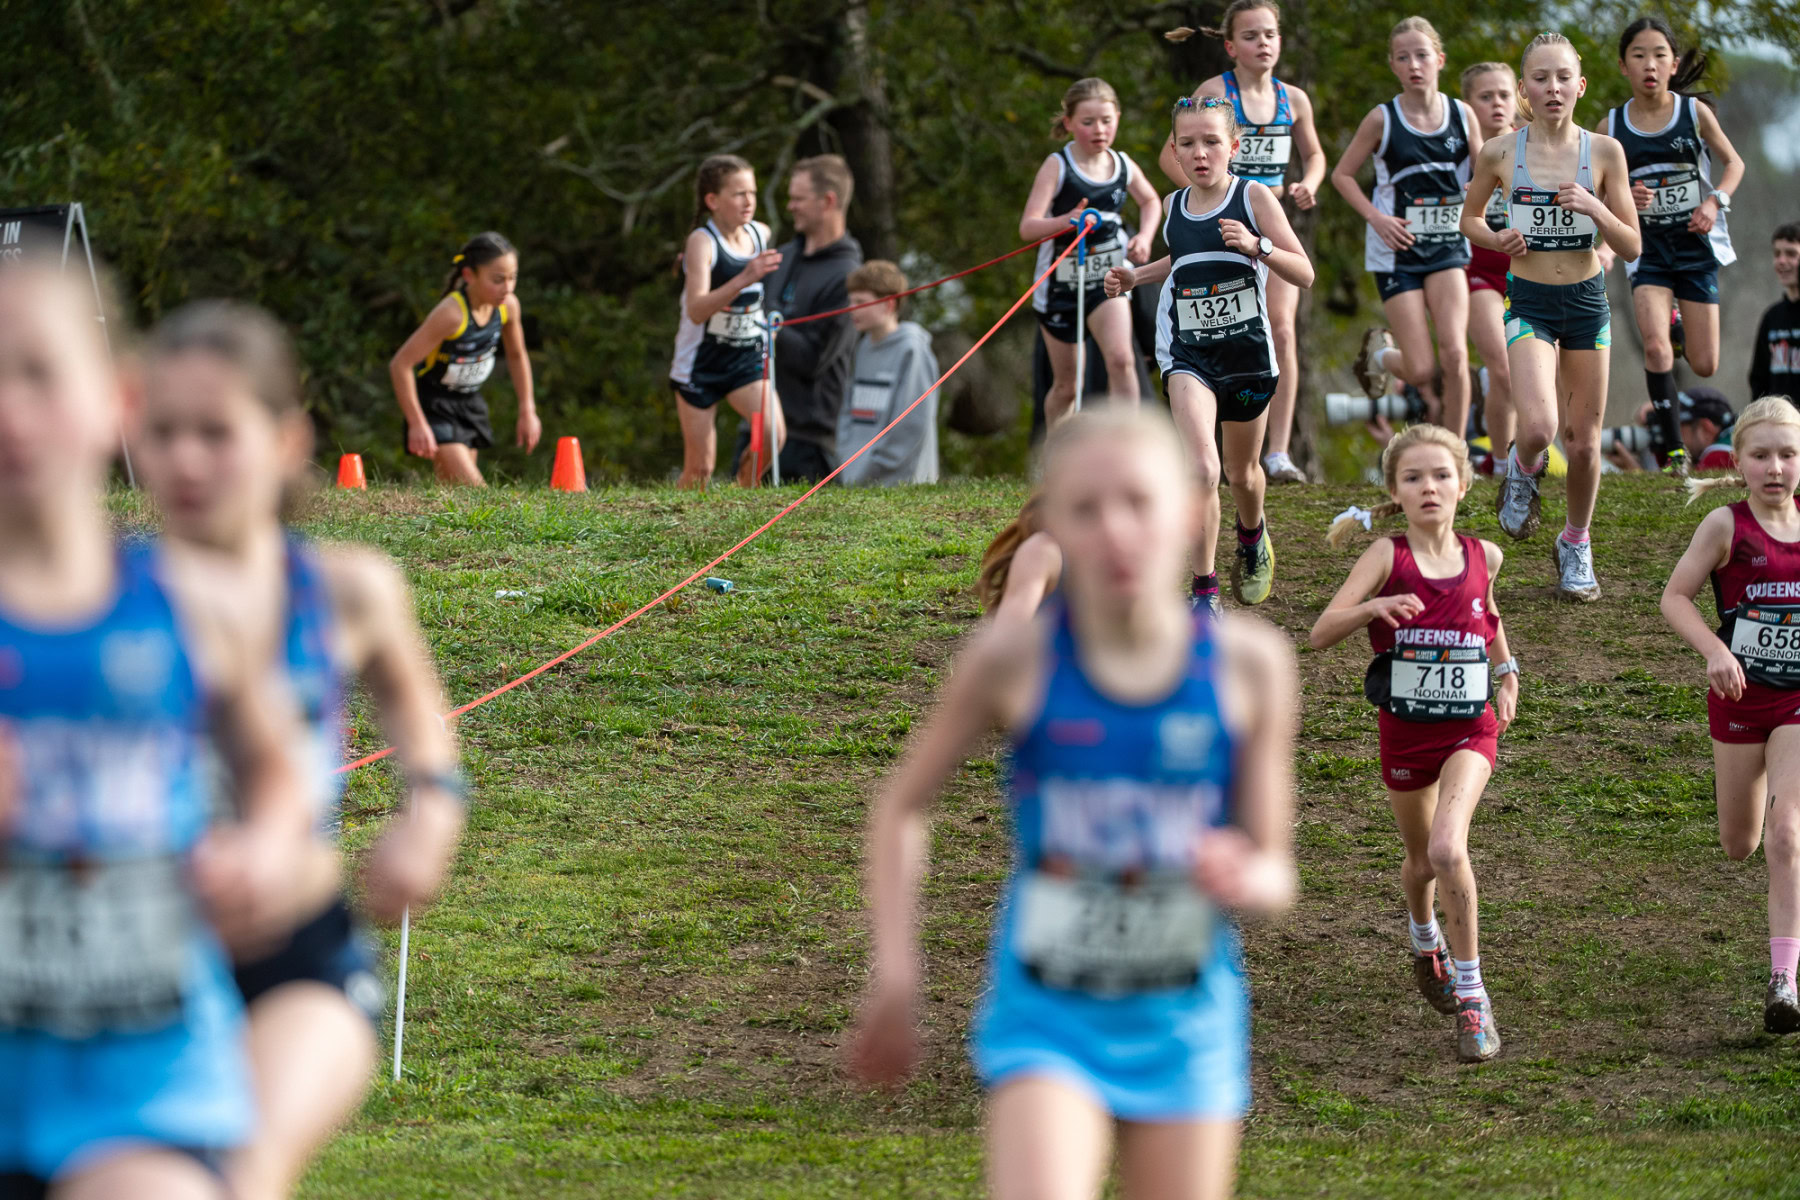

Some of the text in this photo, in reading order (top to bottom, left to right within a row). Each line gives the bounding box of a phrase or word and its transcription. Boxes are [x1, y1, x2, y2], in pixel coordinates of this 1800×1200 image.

[1240, 138, 1275, 155] 374
[1241, 155, 1272, 163] MAHER
[1418, 206, 1459, 224] 1158
[1532, 207, 1574, 227] 918
[1652, 204, 1680, 215] LIANG
[3, 221, 21, 245] IN
[1530, 226, 1577, 235] PERRETT
[1190, 294, 1242, 320] 1321
[1200, 315, 1237, 328] WELSH
[1758, 626, 1800, 650] 658
[1740, 644, 1800, 660] KINGSNOR
[1416, 666, 1465, 689] 718
[1413, 688, 1467, 700] NOONAN
